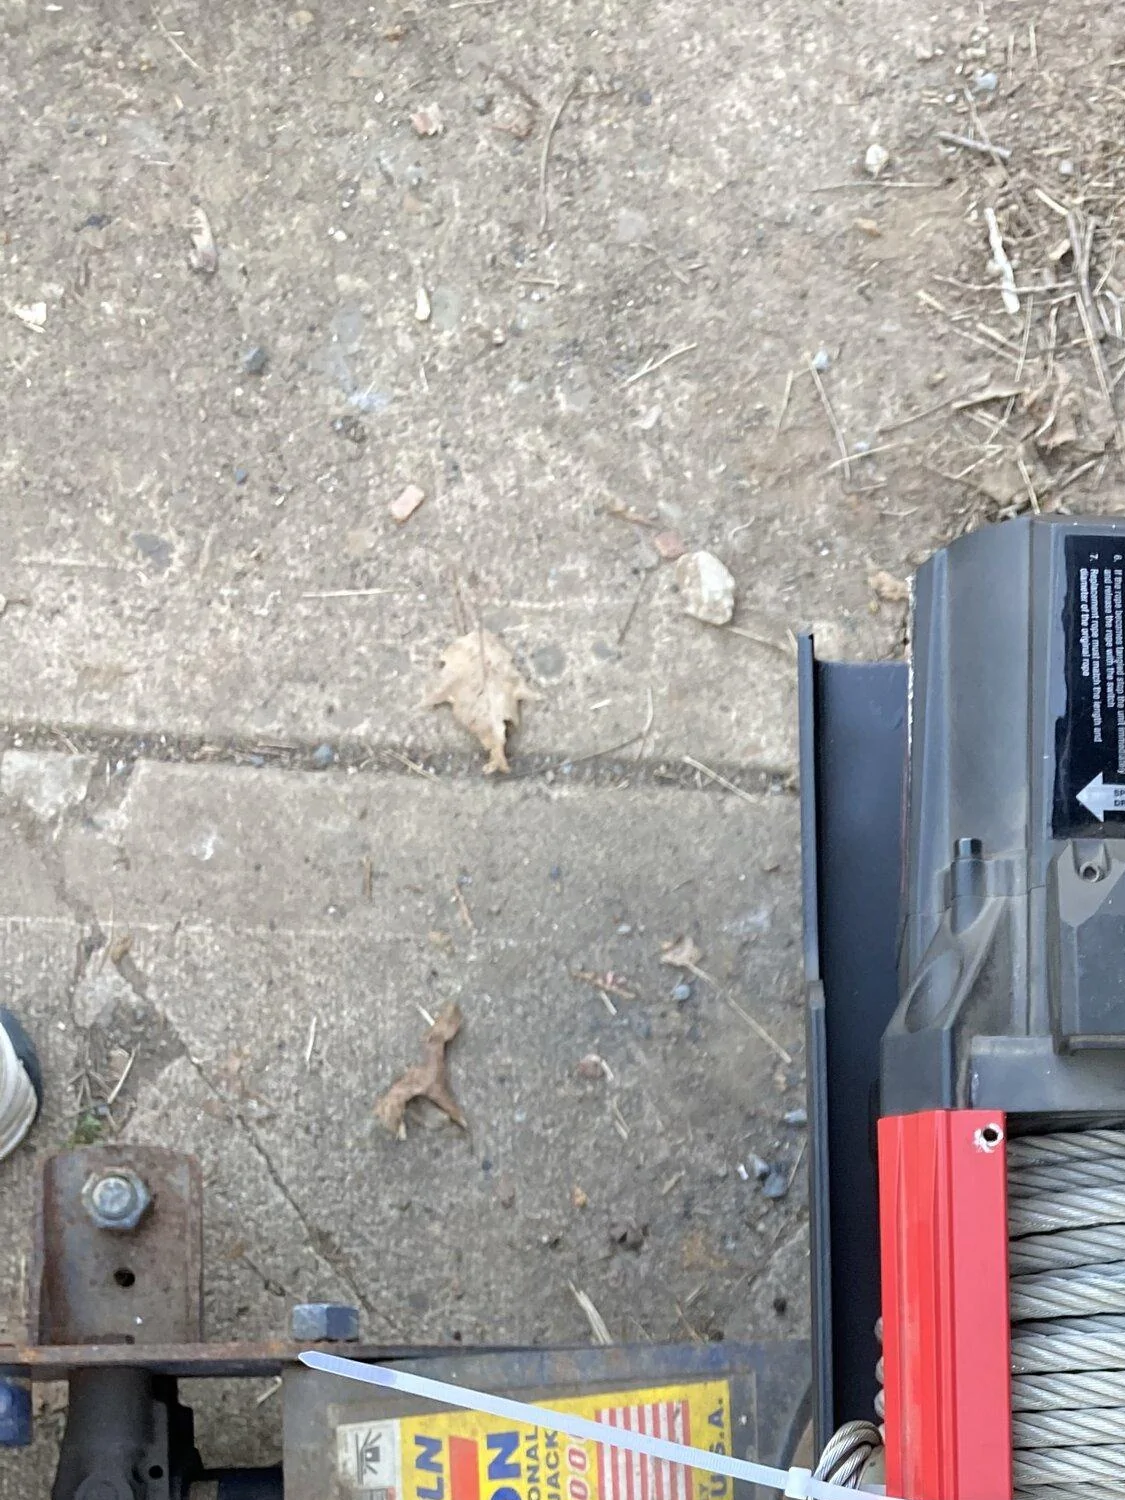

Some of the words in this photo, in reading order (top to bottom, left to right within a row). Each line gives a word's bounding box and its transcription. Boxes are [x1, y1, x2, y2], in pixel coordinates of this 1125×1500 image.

[1090, 553, 1098, 561] 7.
[1104, 569, 1112, 583] and
[1114, 577, 1122, 589] the
[1080, 568, 1089, 602] diameter
[1089, 569, 1099, 619] Replacement
[1104, 585, 1113, 613] release
[1113, 591, 1123, 608] rope
[1081, 604, 1089, 612] of
[1081, 614, 1089, 626] the
[1105, 615, 1114, 628] the
[1115, 610, 1123, 645] becomes
[1090, 620, 1099, 638] rope
[1080, 628, 1090, 657] original
[1104, 630, 1114, 647] rope
[1092, 640, 1100, 659] must
[1106, 649, 1115, 665] with
[1081, 659, 1090, 676] rope
[1114, 647, 1124, 675] tangled
[1092, 661, 1101, 685] match
[1107, 668, 1115, 680] the
[1093, 687, 1101, 699] the
[1107, 681, 1115, 707] switch
[1116, 677, 1125, 694] stop
[1117, 696, 1125, 708] the
[1092, 701, 1102, 725] length
[1118, 710, 1125, 725] unit
[1094, 727, 1102, 742] and
